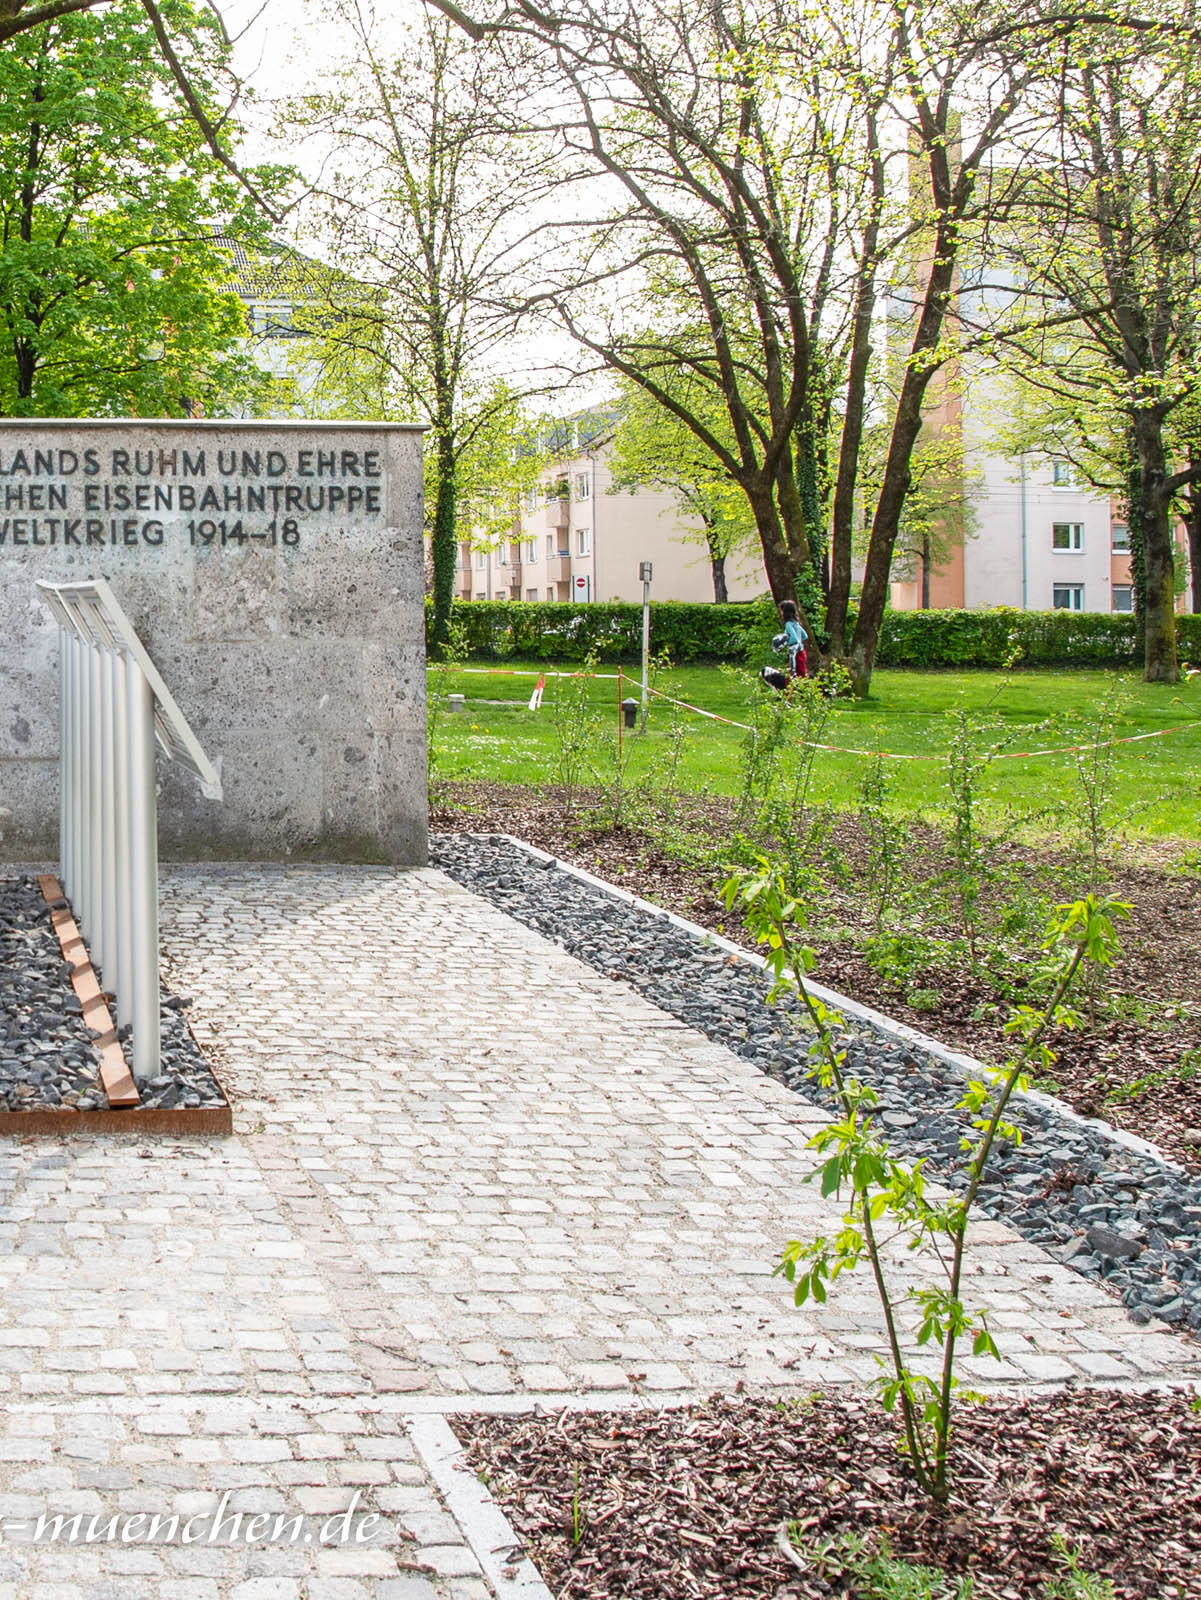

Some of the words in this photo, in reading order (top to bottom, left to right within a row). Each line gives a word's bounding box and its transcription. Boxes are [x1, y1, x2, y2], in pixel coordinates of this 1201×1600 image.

[112, 450, 206, 476] RUHM
[218, 450, 287, 477] UND
[300, 450, 381, 477] EHRE
[85, 485, 381, 512] EISENBAHNTRUPPE
